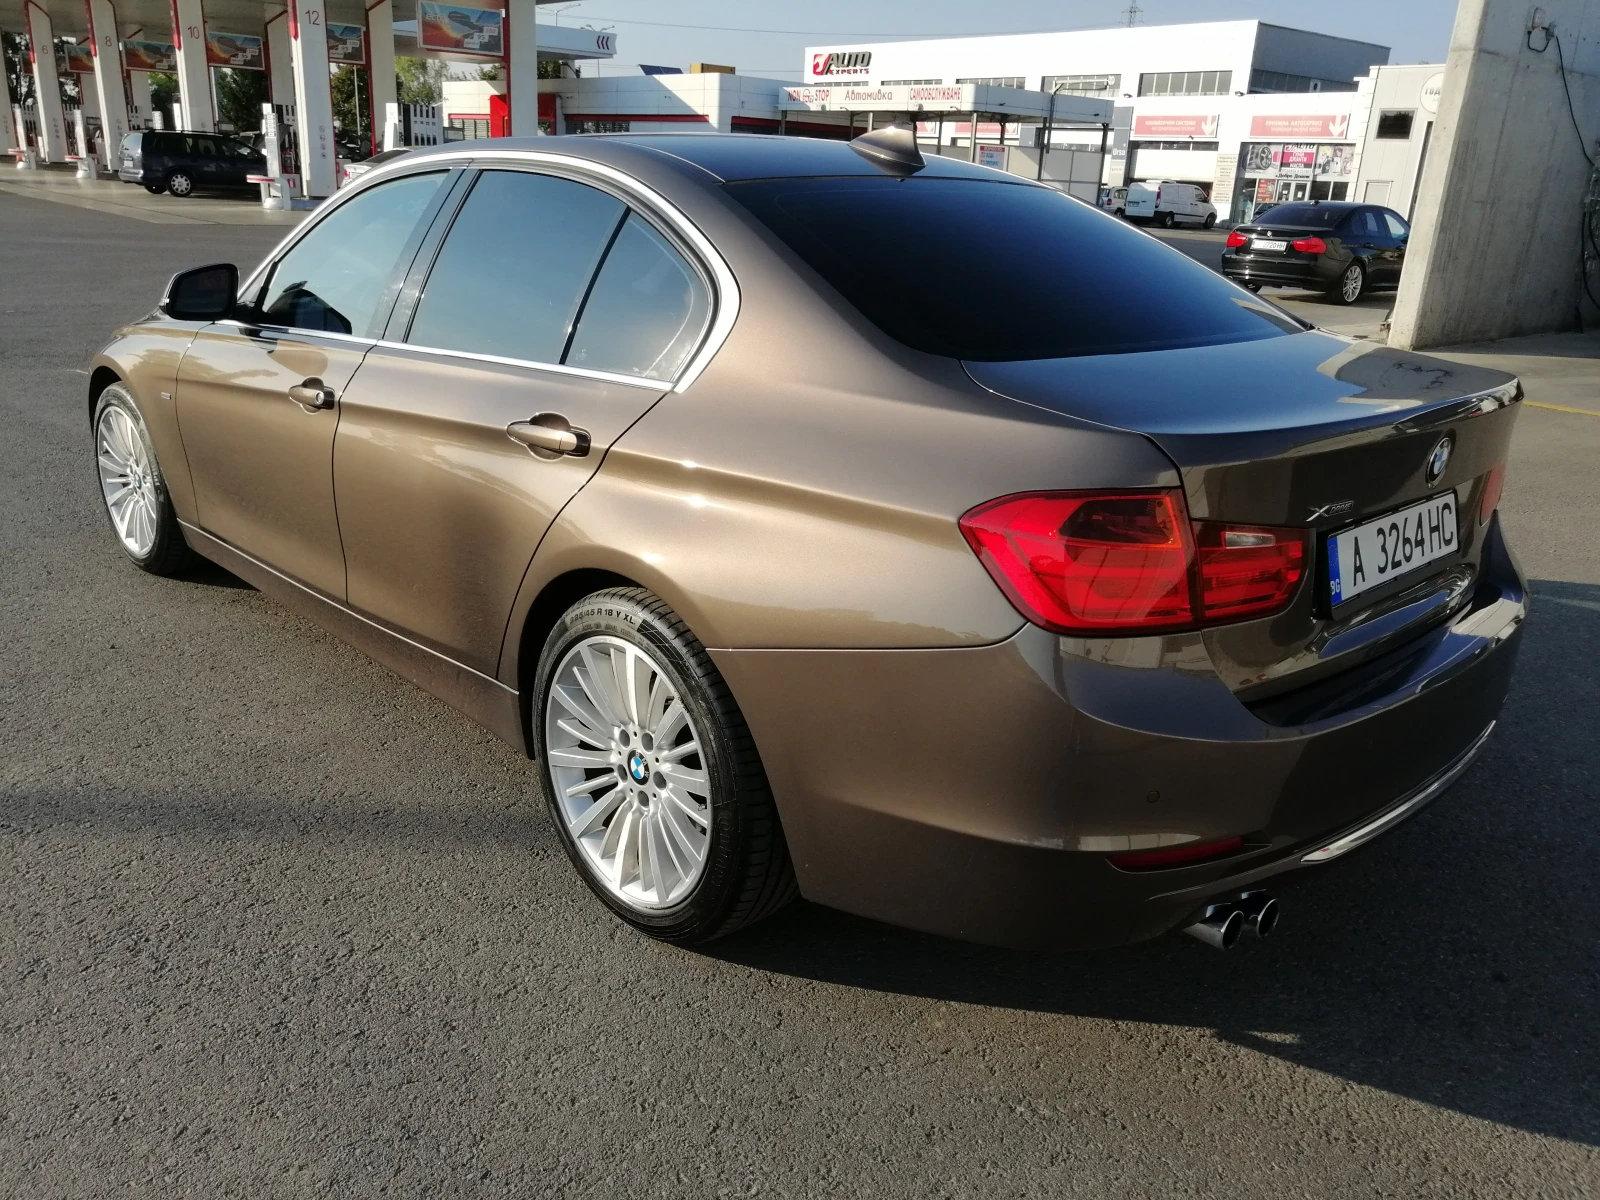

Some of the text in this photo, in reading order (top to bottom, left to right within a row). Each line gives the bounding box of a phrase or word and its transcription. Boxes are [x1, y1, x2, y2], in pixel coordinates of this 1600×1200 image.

[305, 10, 320, 26] 12
[187, 26, 200, 39] 10
[104, 36, 112, 47] 8
[42, 45, 48, 54] 6
[824, 51, 872, 72] AUTO
[787, 89, 830, 102] NON STOP
[844, 88, 893, 101] Автомивка
[909, 87, 961, 101] САМООБСЛУЖВАНЕ
[1352, 502, 1454, 587] A 3264HC
[1329, 578, 1341, 594] BG
[596, 608, 603, 616] R
[604, 608, 613, 617] 18
[615, 610, 622, 618] Y
[623, 613, 635, 625] XL
